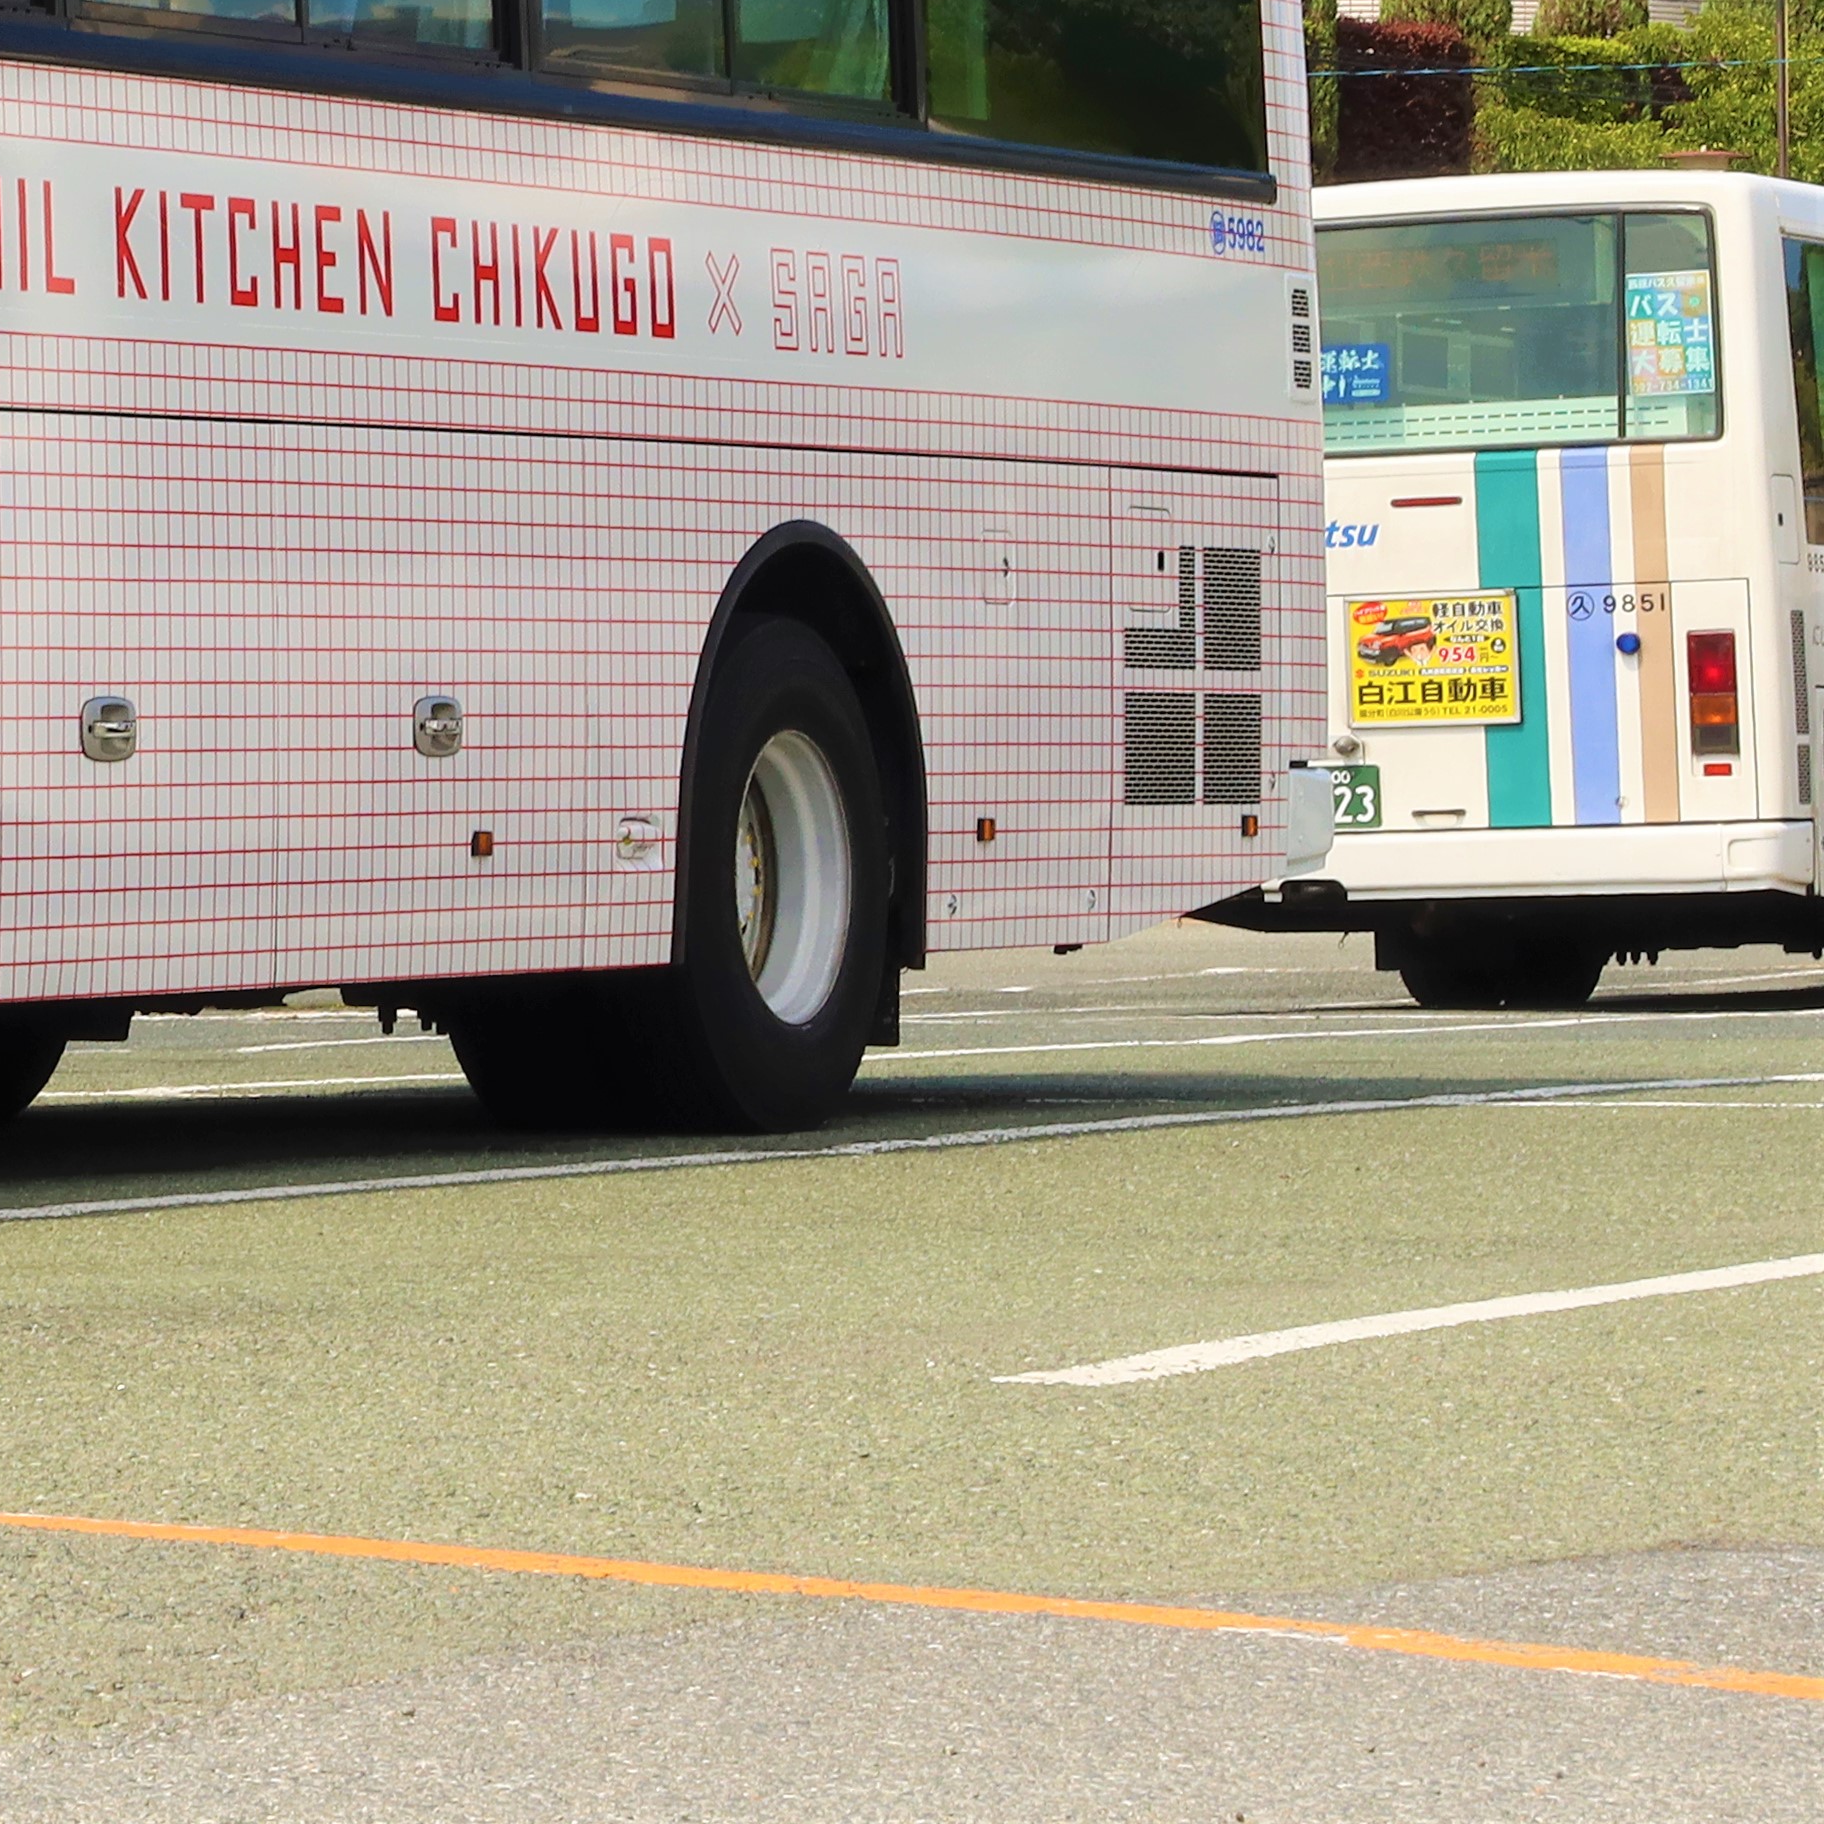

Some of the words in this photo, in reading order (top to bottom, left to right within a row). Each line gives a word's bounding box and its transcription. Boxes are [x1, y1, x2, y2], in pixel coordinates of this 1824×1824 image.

[1227, 217, 1265, 253] 5982
[114, 185, 395, 319] KITCHEN
[430, 215, 677, 342] CHIKUGO
[769, 246, 905, 360] SAGA
[1629, 292, 1679, 318] バス
[1630, 317, 1709, 346] 運転士
[1631, 346, 1711, 376] 大募集
[1432, 601, 1503, 618] 軽自動車
[1602, 592, 1666, 614] 9851
[1433, 617, 1504, 634] オイル交換
[1368, 669, 1416, 678] SUZUKI
[1357, 677, 1509, 707] 白江自動車
[1442, 706, 1462, 716] TEL
[1333, 784, 1376, 824] 23
